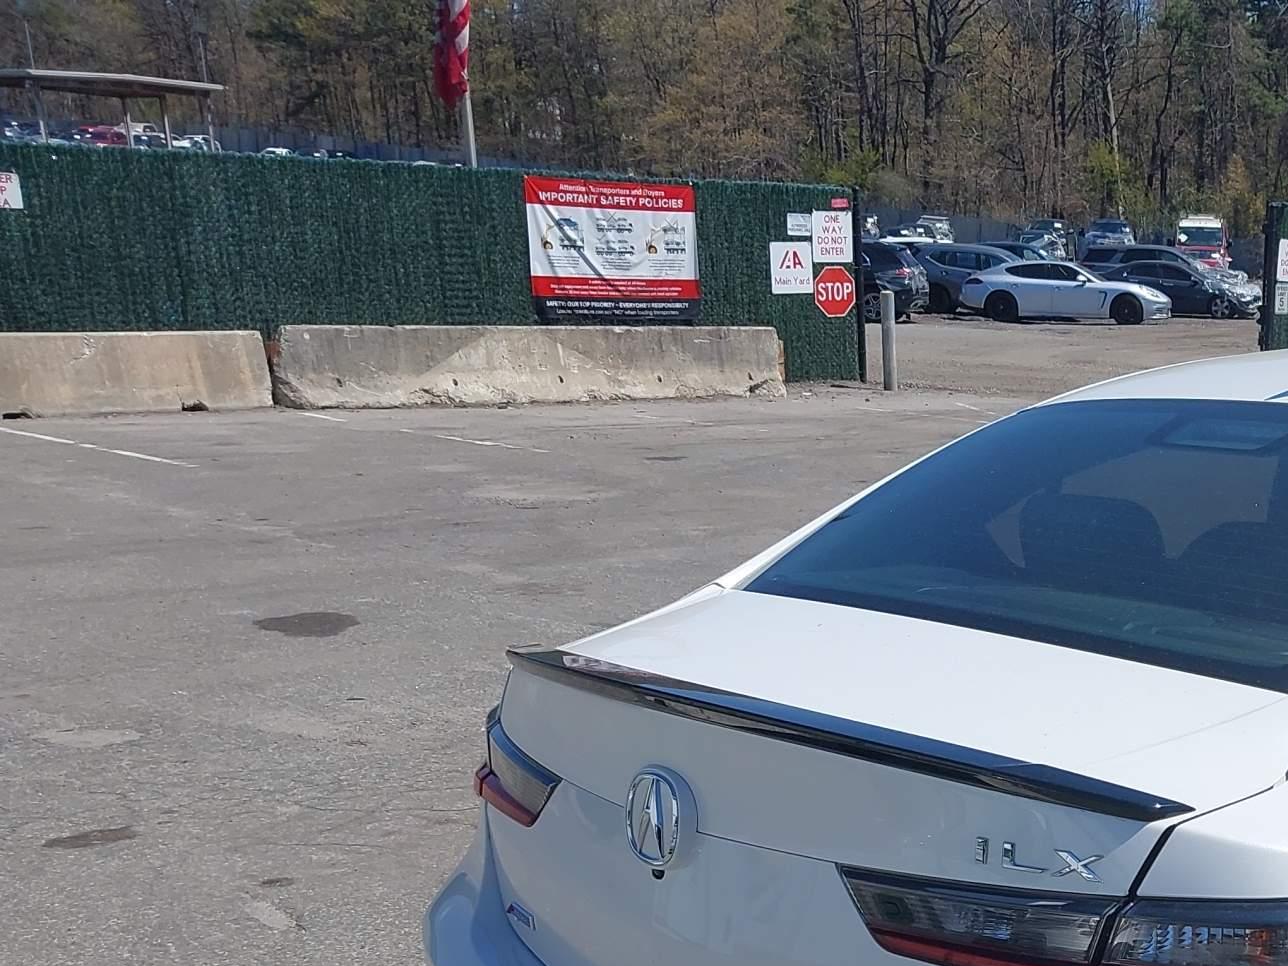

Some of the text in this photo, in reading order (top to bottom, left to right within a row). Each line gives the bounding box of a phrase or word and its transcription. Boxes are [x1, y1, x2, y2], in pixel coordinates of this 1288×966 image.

[538, 191, 684, 209] IMPORTANT SAFETY POLICIES
[823, 214, 841, 225] ONE
[821, 226, 844, 235] WAY
[817, 236, 848, 246] DO NOT
[820, 247, 844, 255] ENTER
[774, 276, 811, 286] Main Yard
[817, 282, 852, 302] STOP
[1279, 297, 1285, 308] 5
[975, 836, 1105, 883] ILX
